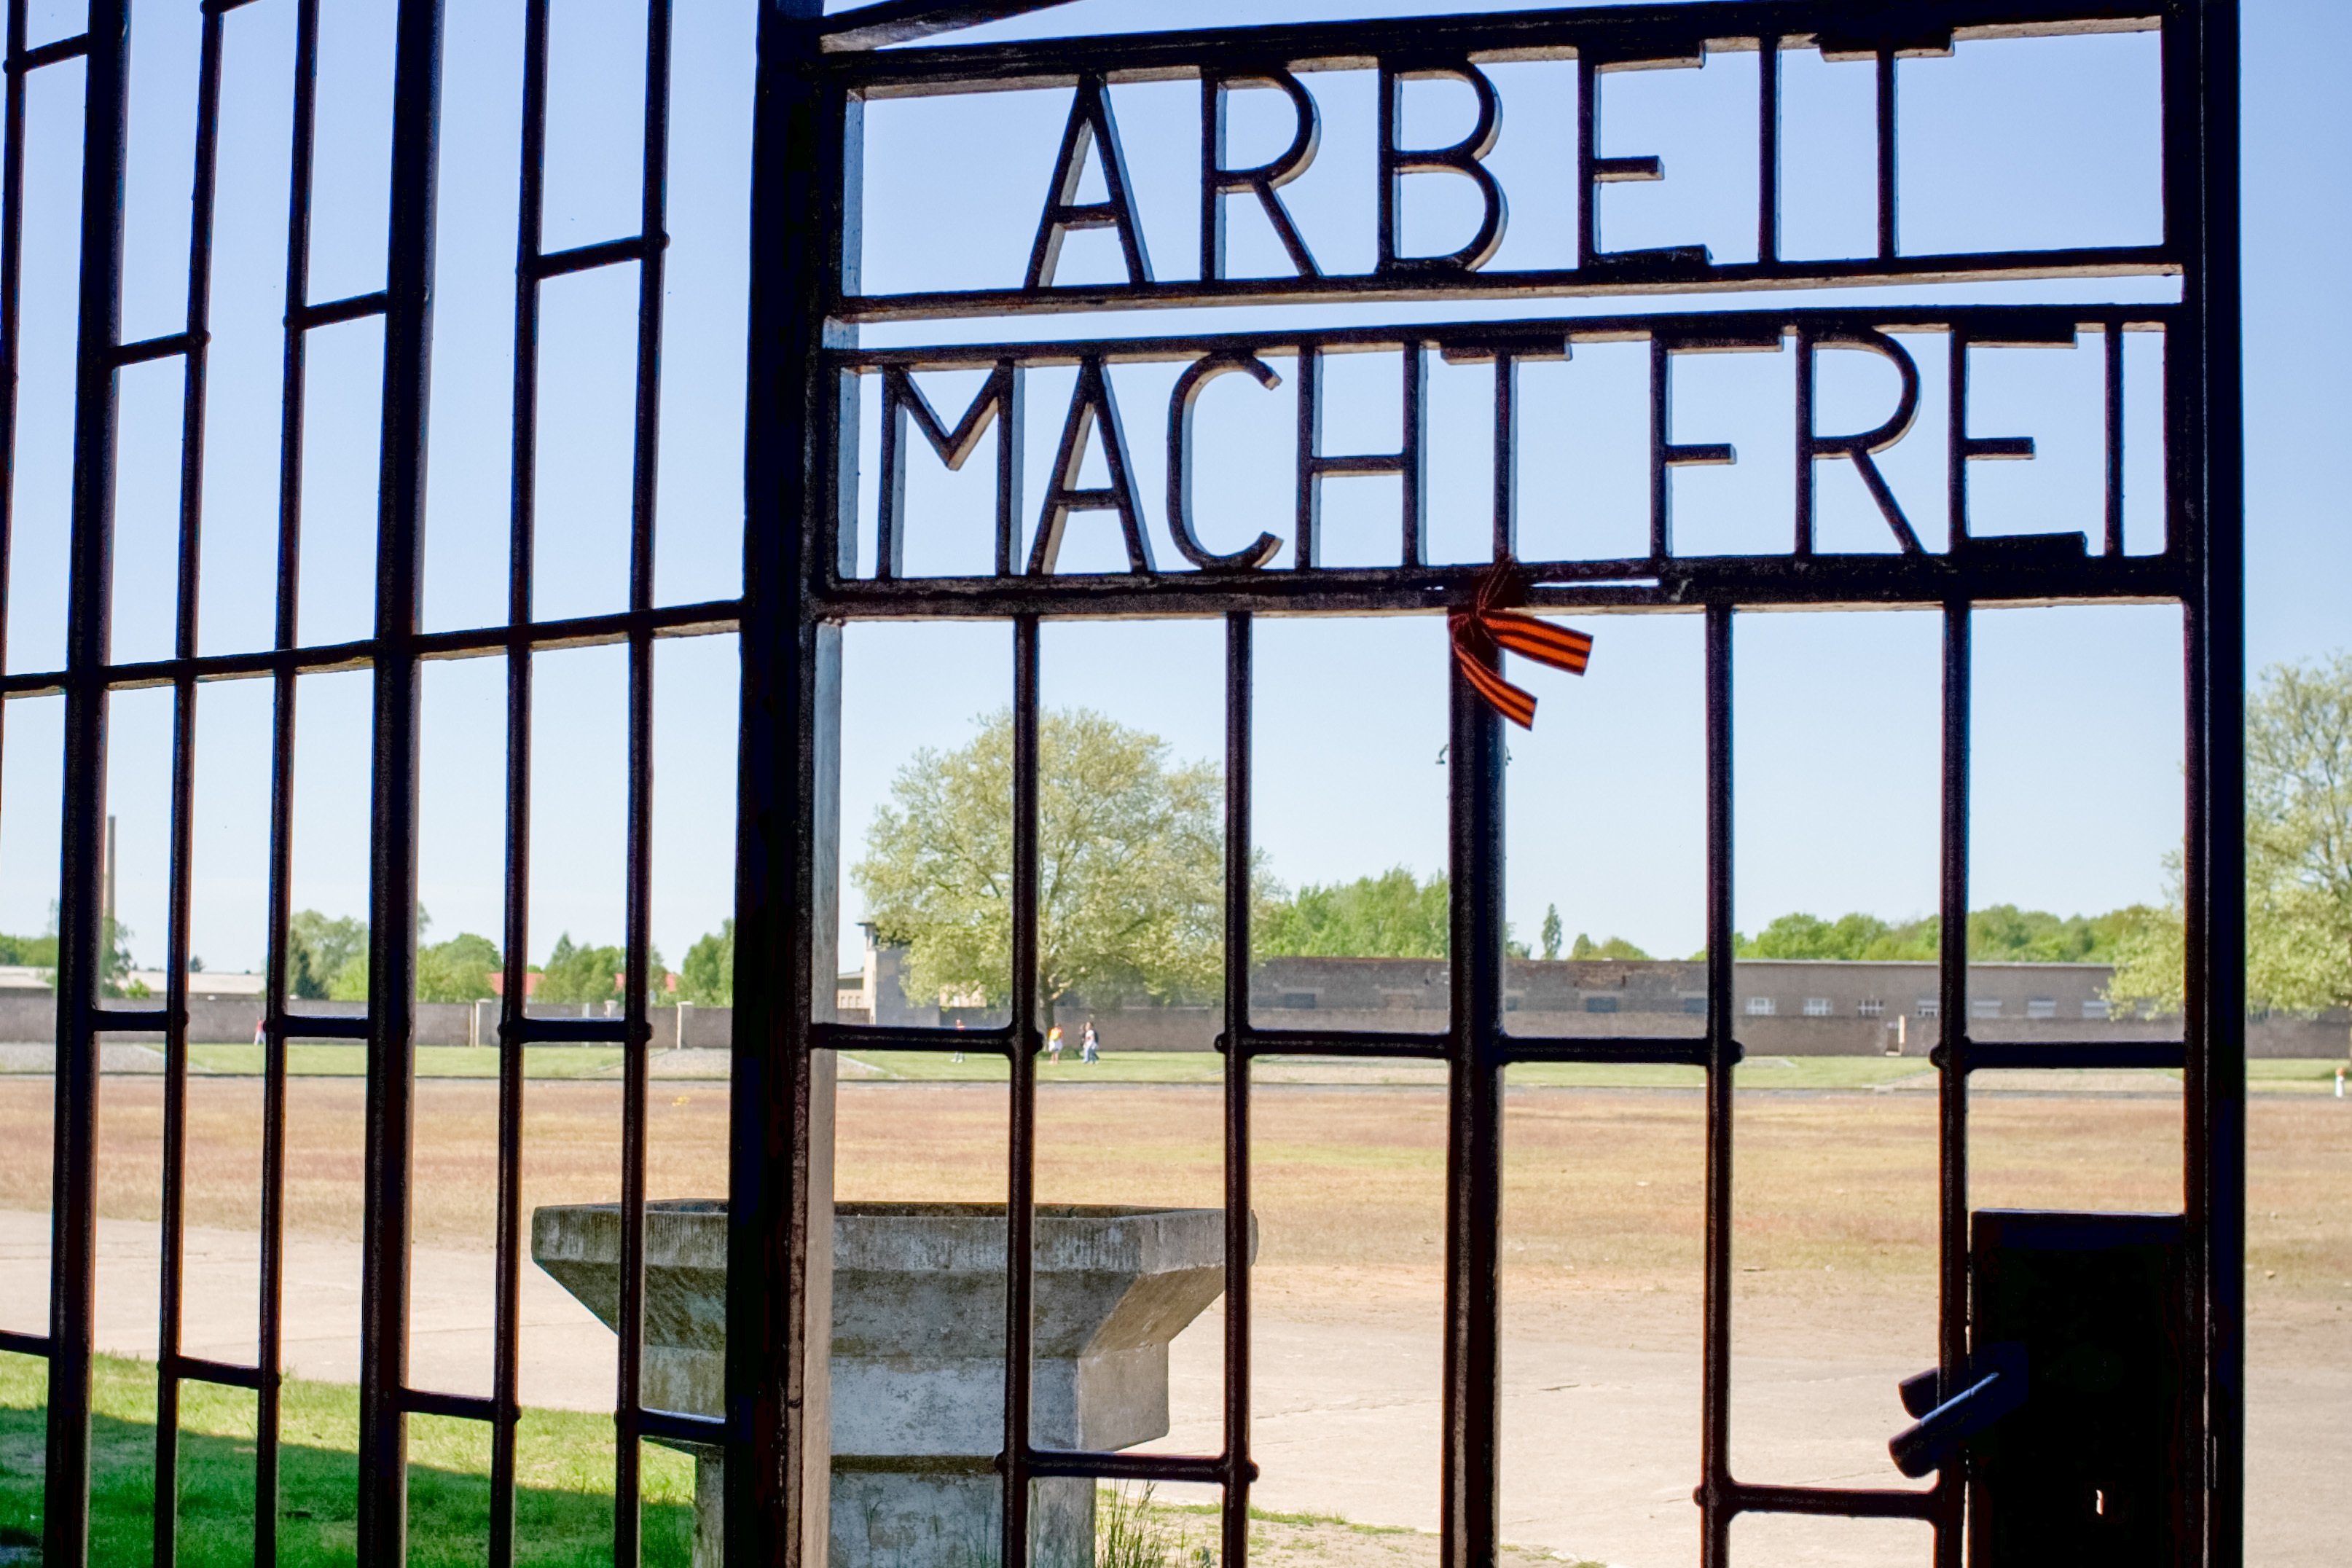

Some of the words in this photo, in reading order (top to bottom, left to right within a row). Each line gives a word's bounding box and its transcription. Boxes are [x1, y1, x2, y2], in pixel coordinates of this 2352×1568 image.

[1024, 34, 1956, 290] ARBEIT
[877, 332, 1574, 580] MACHT
[1649, 317, 2126, 561] FREI
